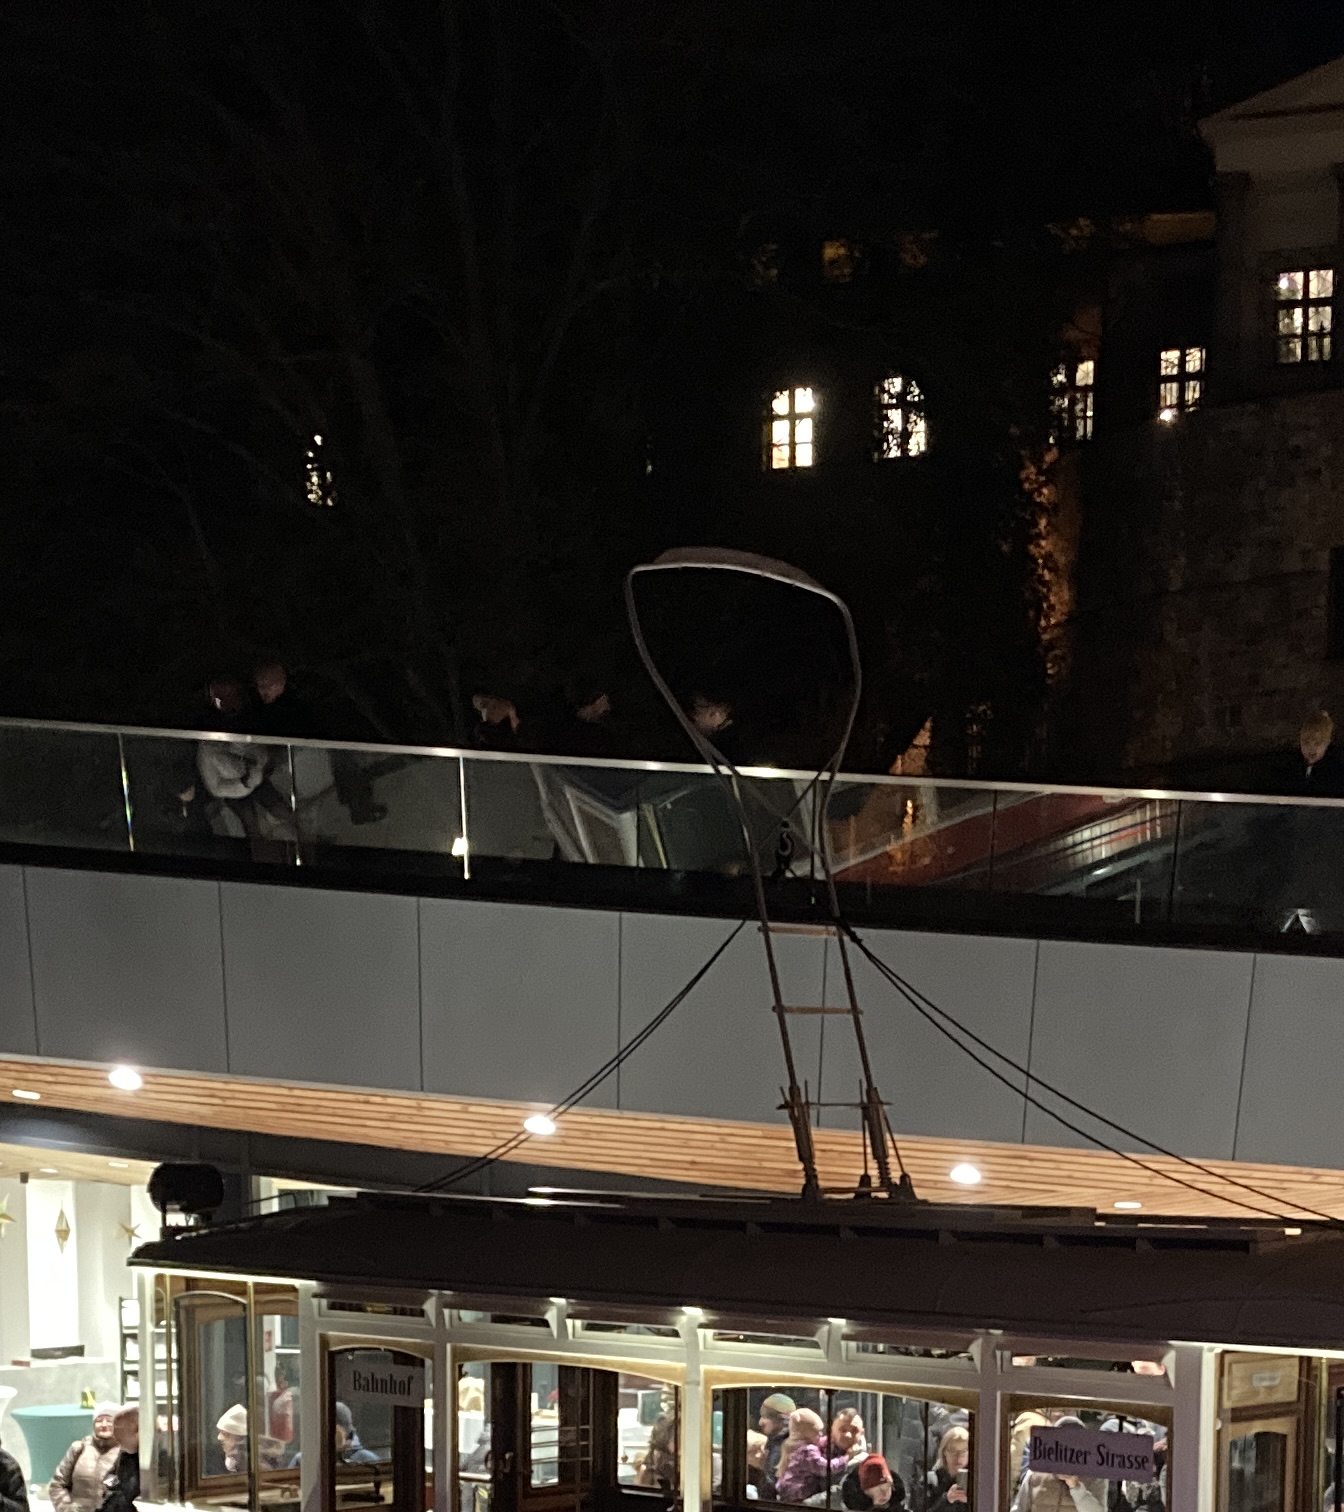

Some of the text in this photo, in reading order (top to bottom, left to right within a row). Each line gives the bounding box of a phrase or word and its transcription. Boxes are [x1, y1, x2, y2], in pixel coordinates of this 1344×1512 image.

[353, 1370, 414, 1396] Bahnhof
[1032, 1436, 1149, 1470] Bielitzer Strasse
